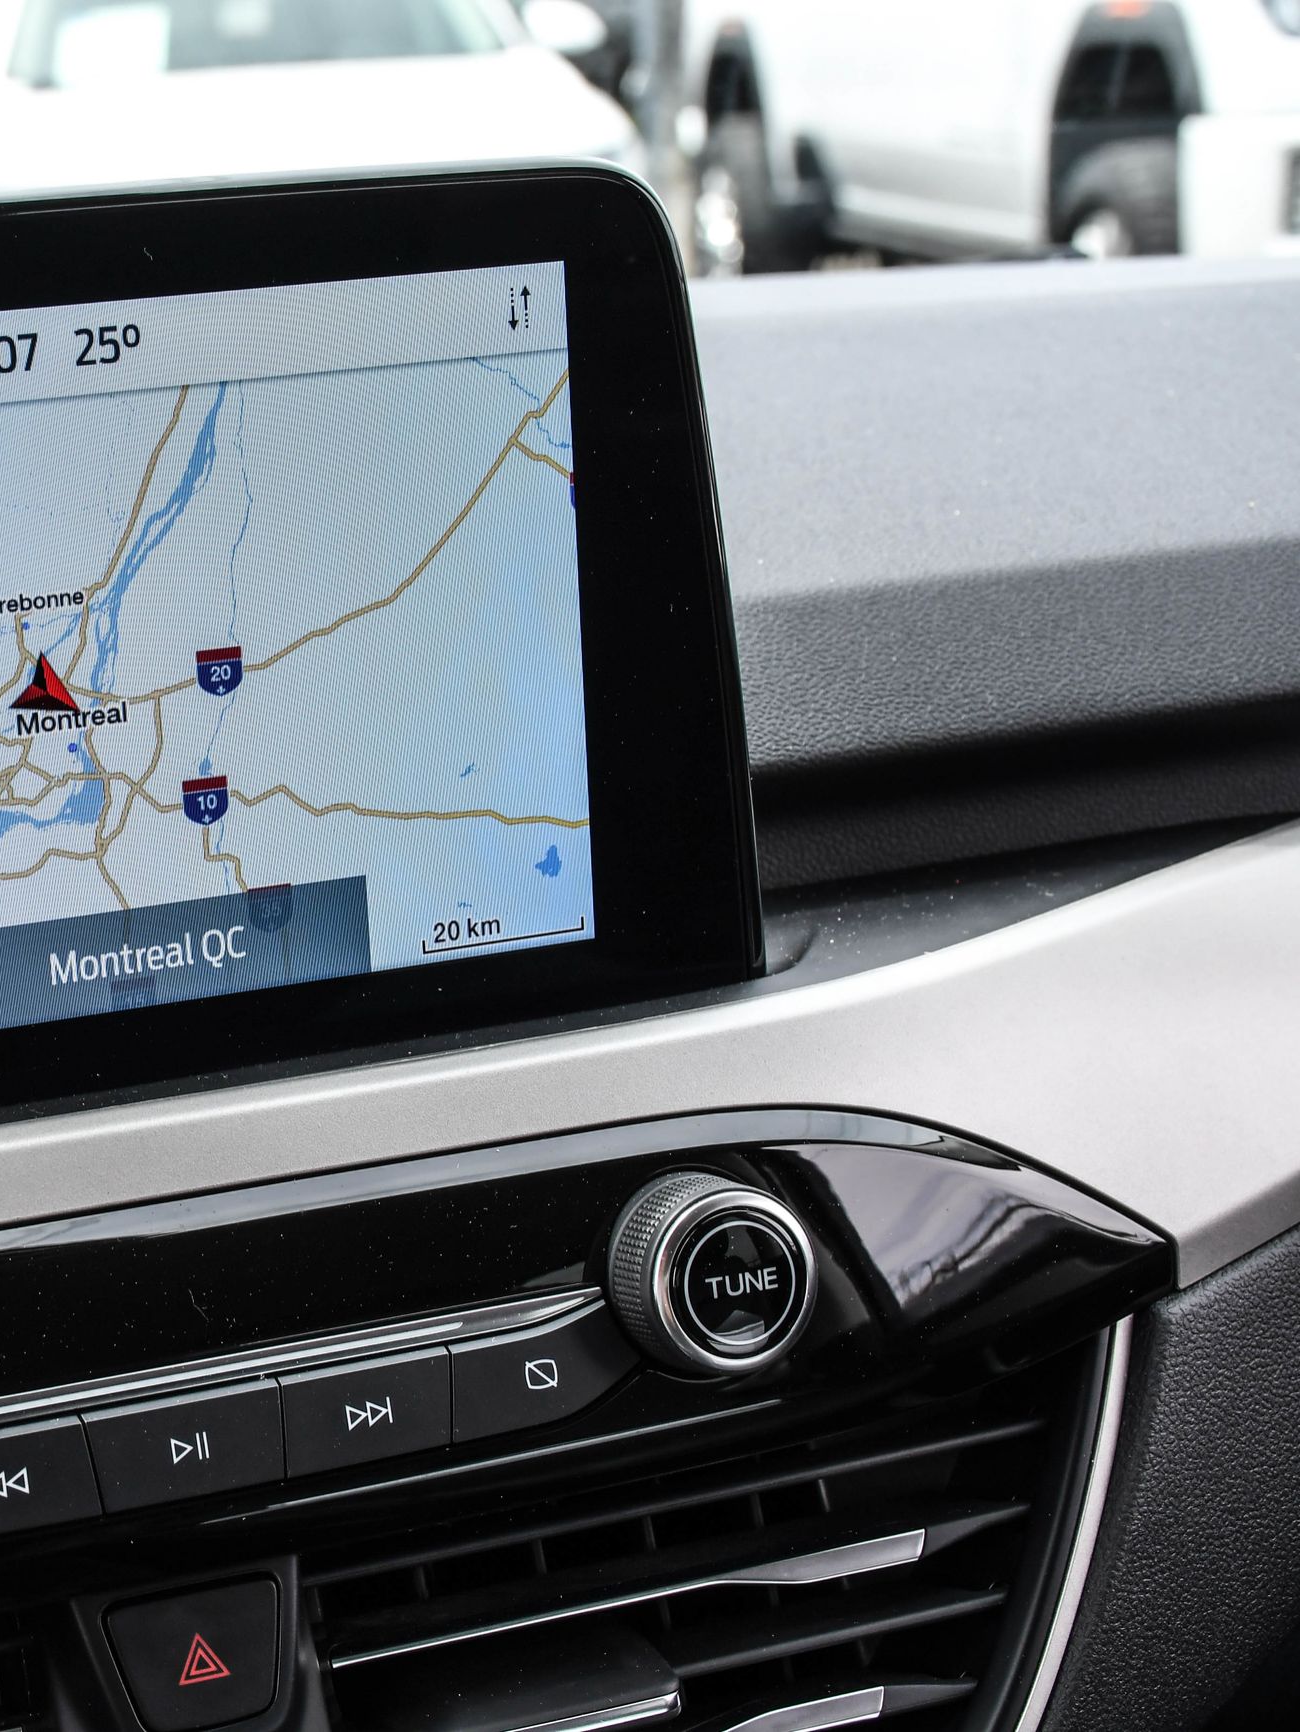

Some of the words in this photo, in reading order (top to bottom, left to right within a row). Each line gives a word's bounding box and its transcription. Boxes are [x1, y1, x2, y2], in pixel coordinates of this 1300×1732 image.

[73, 323, 141, 367] 25°
[209, 664, 232, 682] 20
[16, 701, 128, 737] Montreal
[197, 793, 218, 810] 10
[432, 920, 461, 944] 20
[467, 917, 501, 939] km
[49, 931, 194, 986] Montreal
[201, 925, 247, 968] QC
[704, 1266, 779, 1300] TUNE
